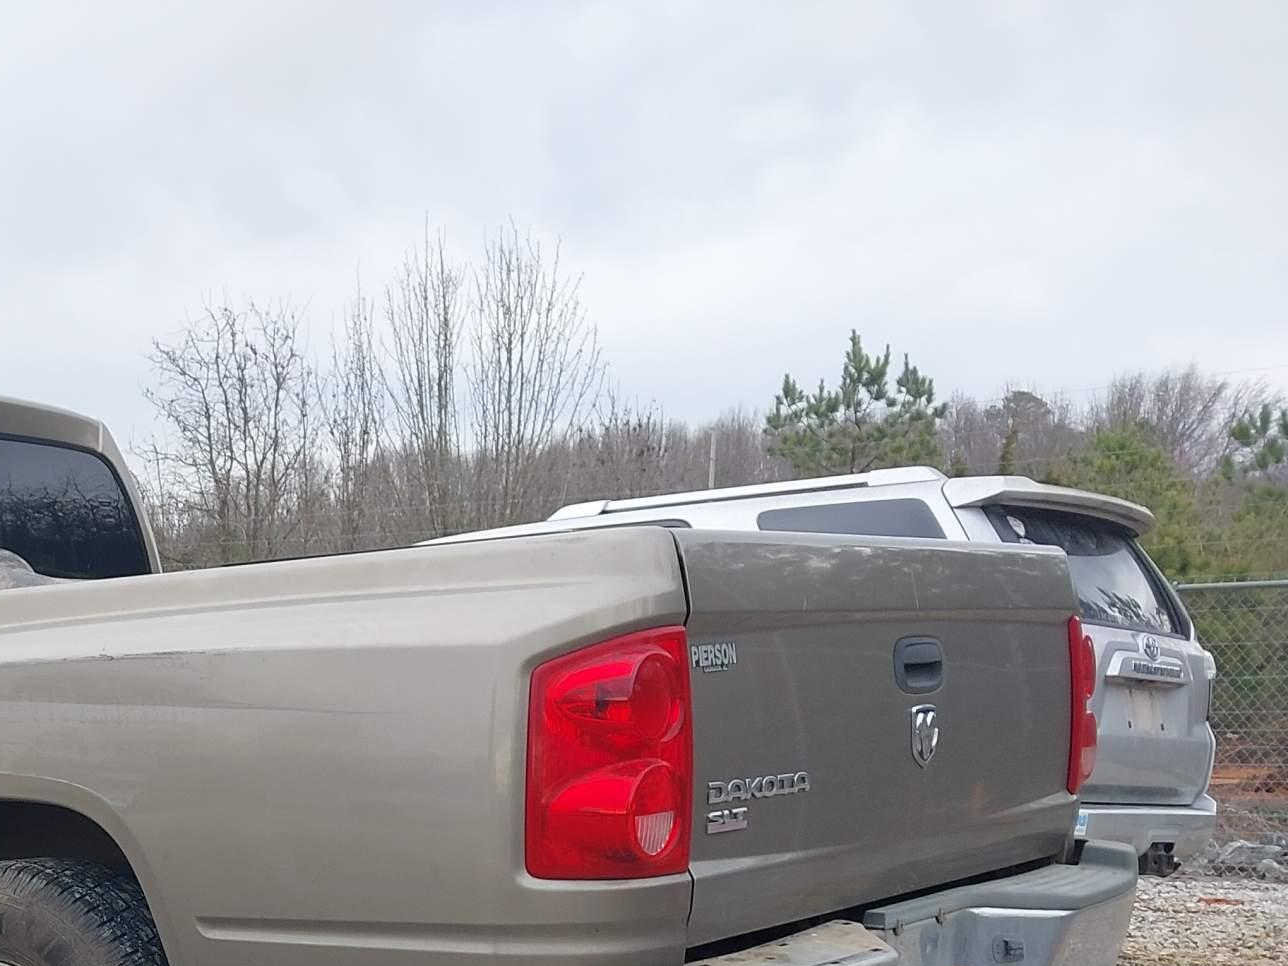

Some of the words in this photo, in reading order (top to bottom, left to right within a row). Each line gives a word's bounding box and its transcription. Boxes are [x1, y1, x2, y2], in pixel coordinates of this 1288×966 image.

[691, 642, 737, 667] PIERSON
[708, 771, 811, 804] DAKOTA
[706, 807, 748, 827] SLT
